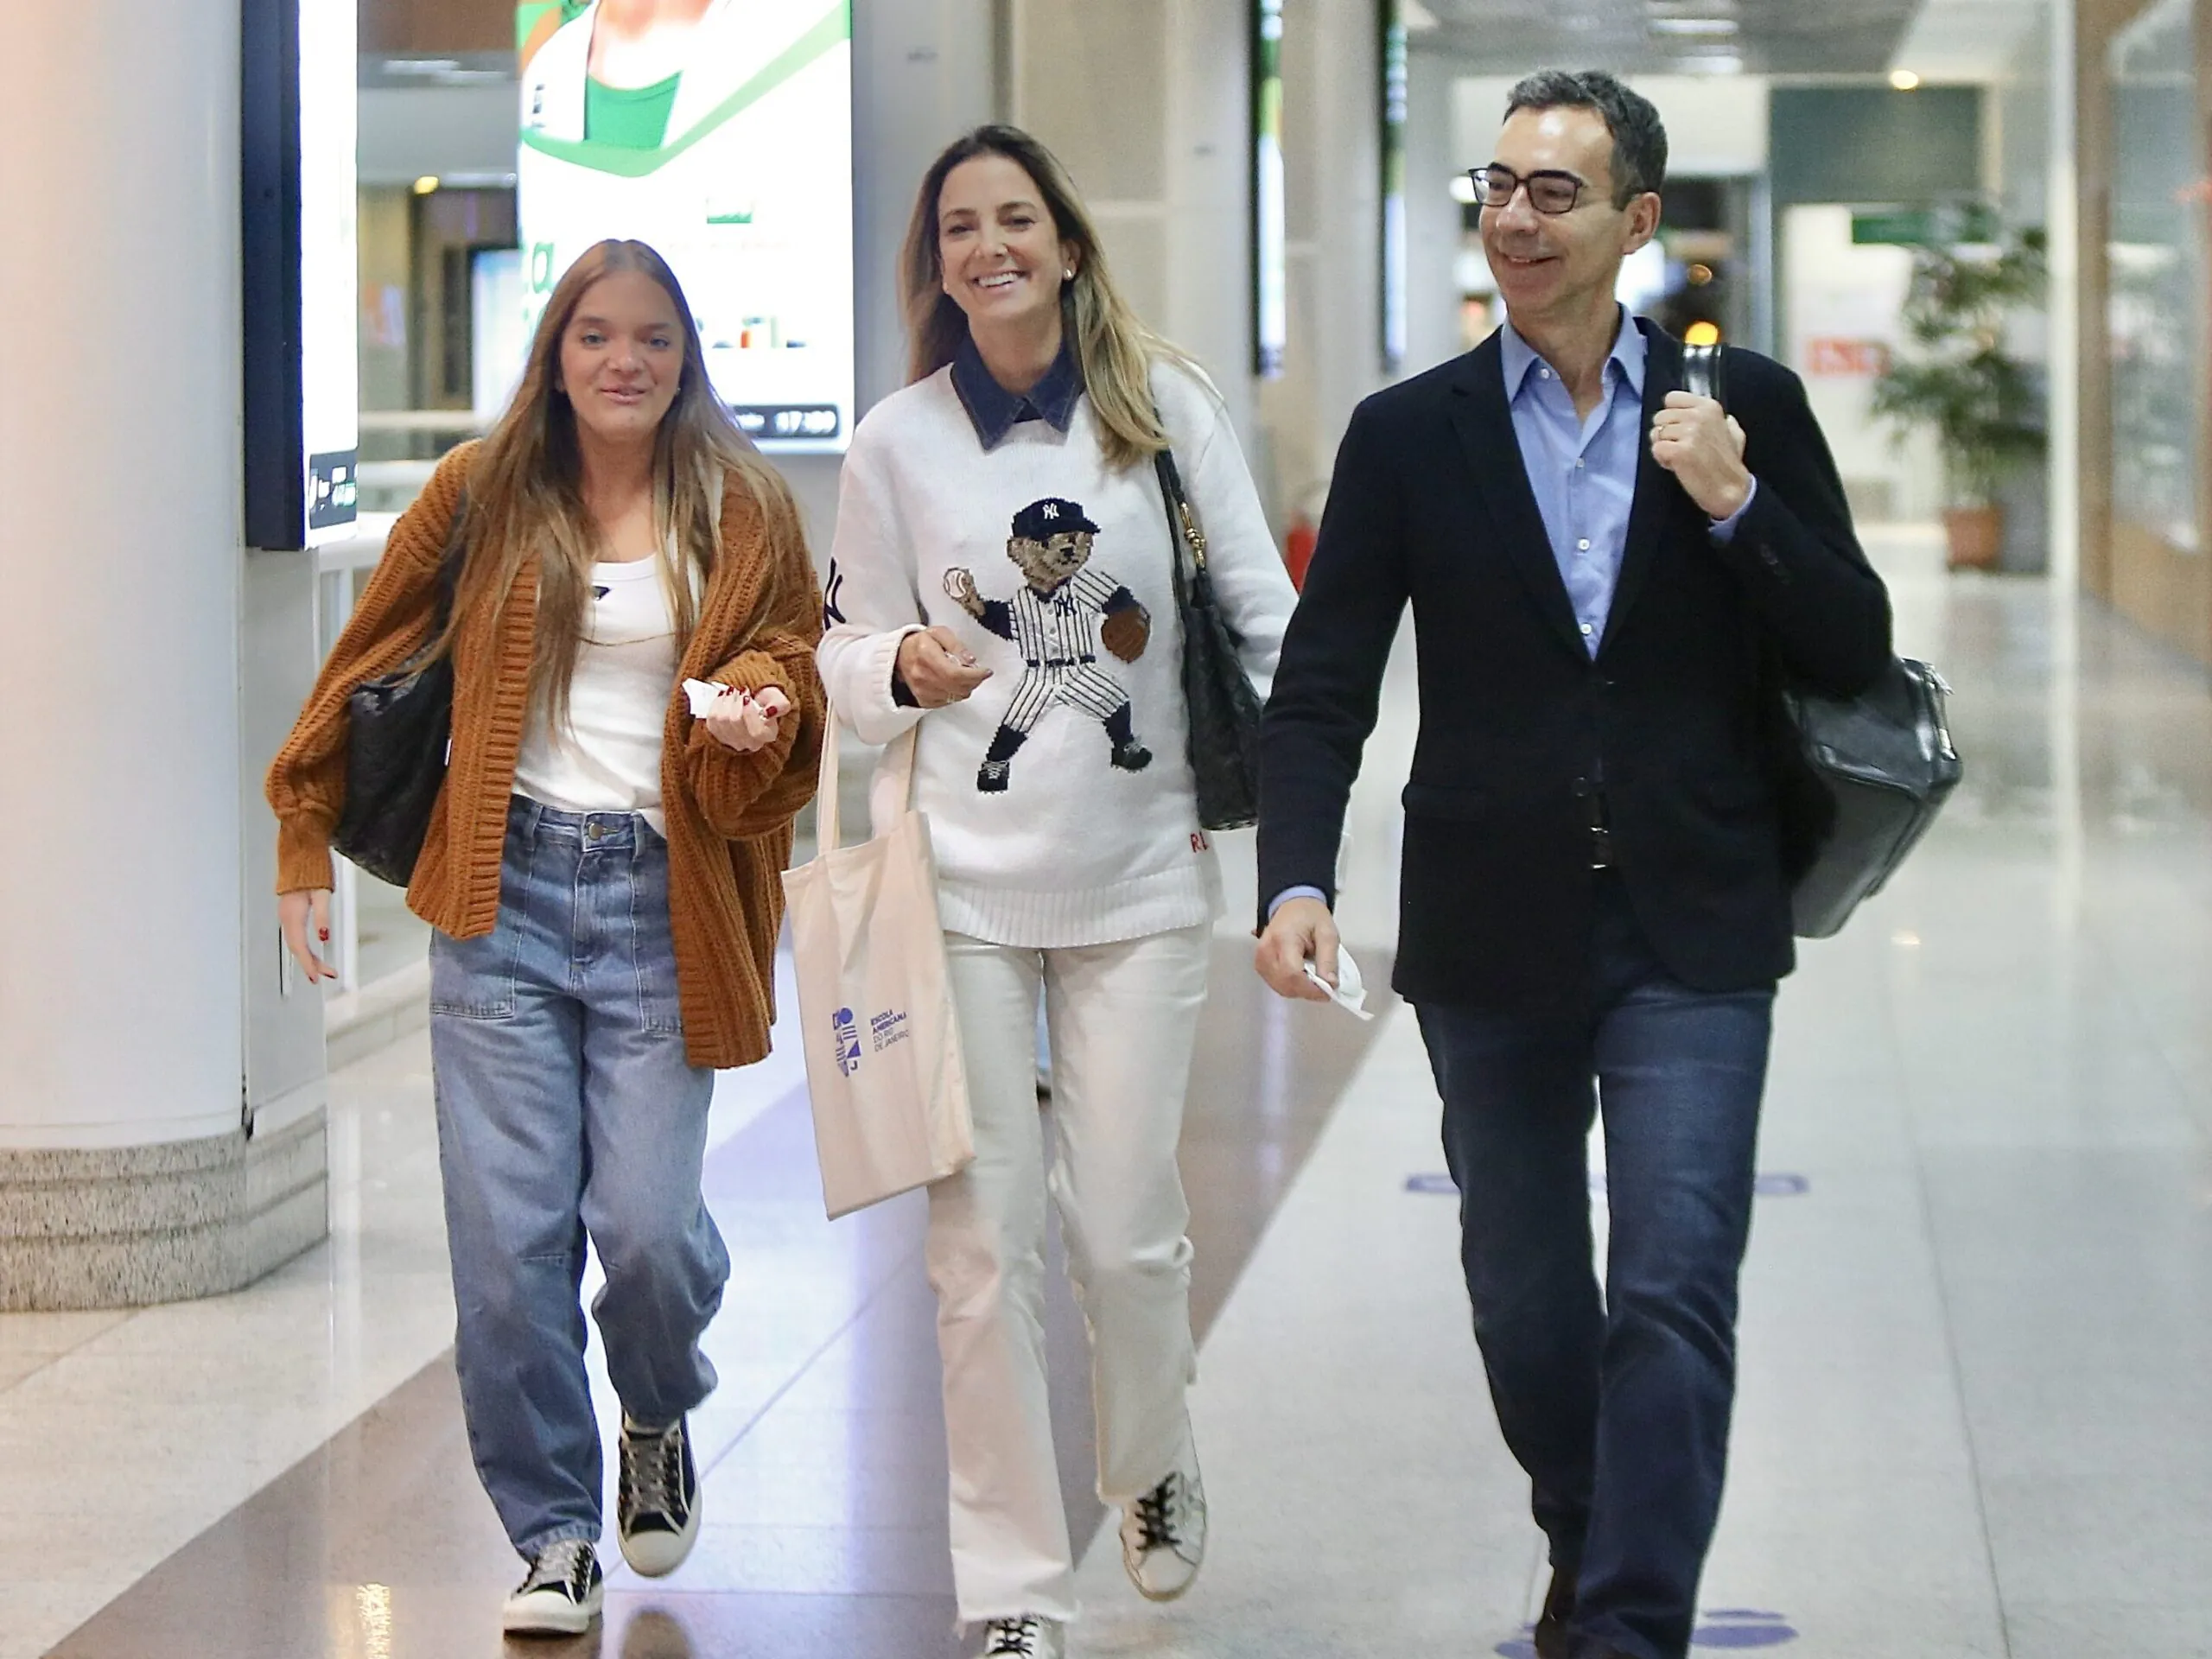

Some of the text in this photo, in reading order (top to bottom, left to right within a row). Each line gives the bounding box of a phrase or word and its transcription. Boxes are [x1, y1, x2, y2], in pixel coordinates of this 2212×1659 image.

[870, 1008, 893, 1027] ESCOLA
[873, 1011, 907, 1035] AMERICANA
[873, 1027, 893, 1044] DO RIO
[874, 1042, 884, 1052] DE
